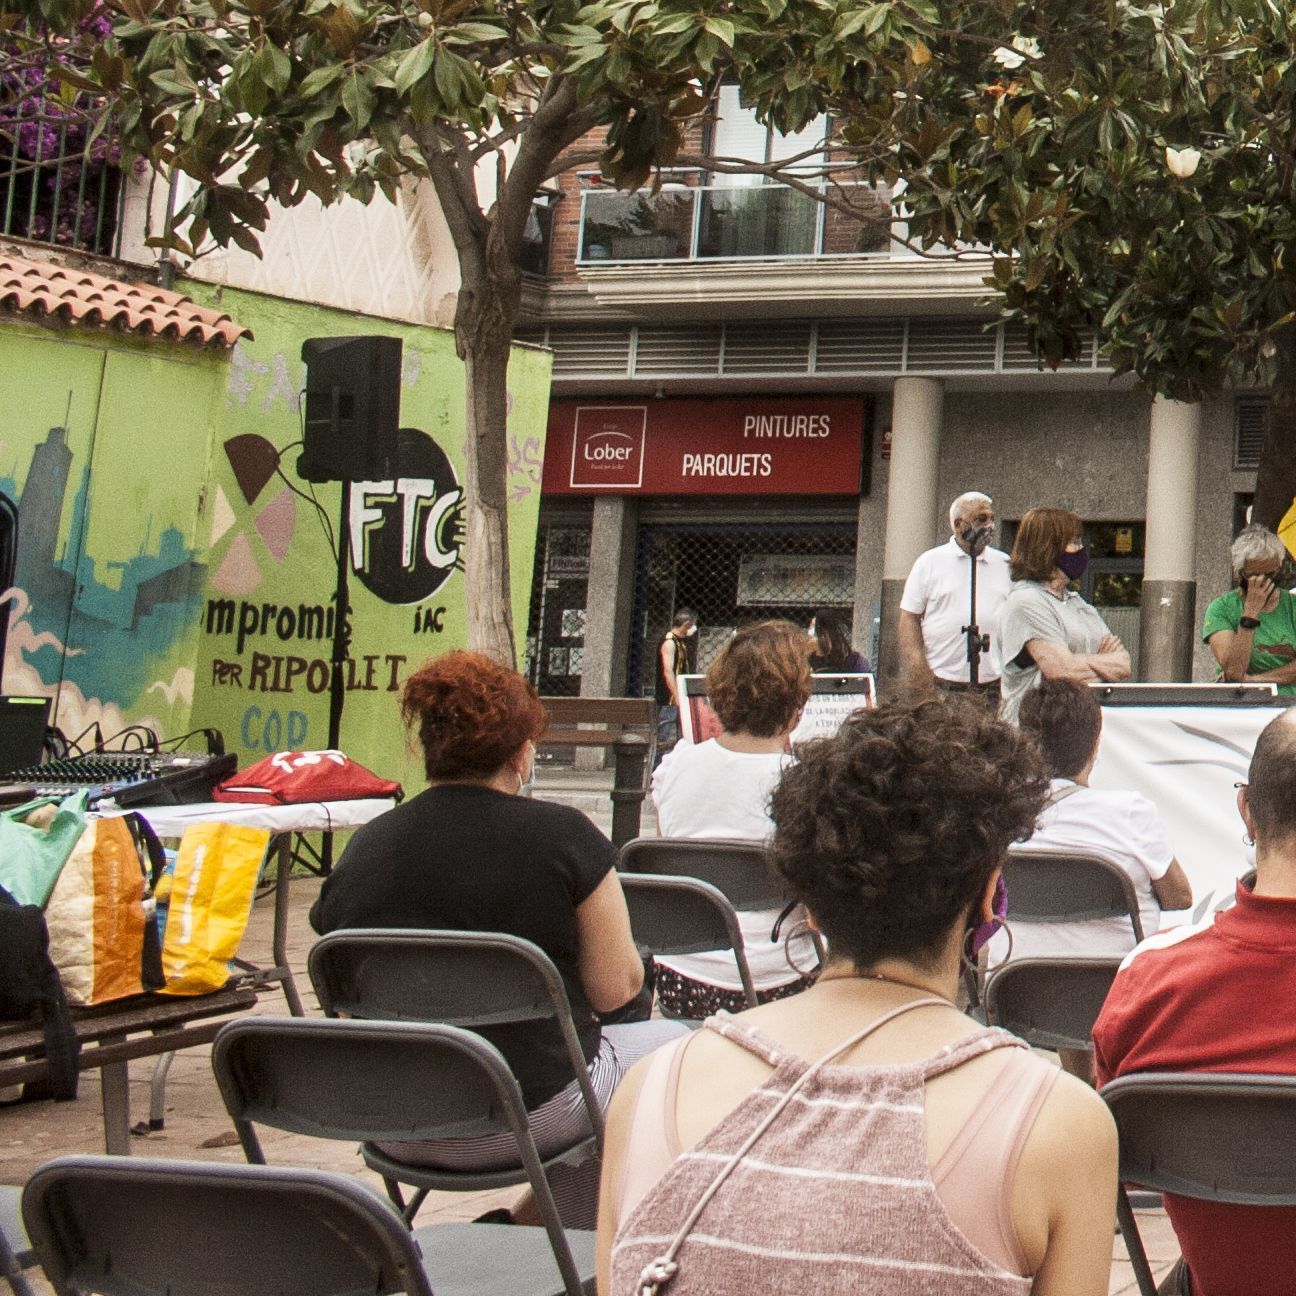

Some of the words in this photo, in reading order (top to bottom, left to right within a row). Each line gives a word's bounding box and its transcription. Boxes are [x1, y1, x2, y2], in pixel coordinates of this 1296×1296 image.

[744, 415, 830, 438] PINTURES
[584, 443, 633, 460] Lober
[682, 453, 772, 477] PARQUETS
[350, 478, 461, 570] FTC
[248, 650, 408, 694] RIPOLET
